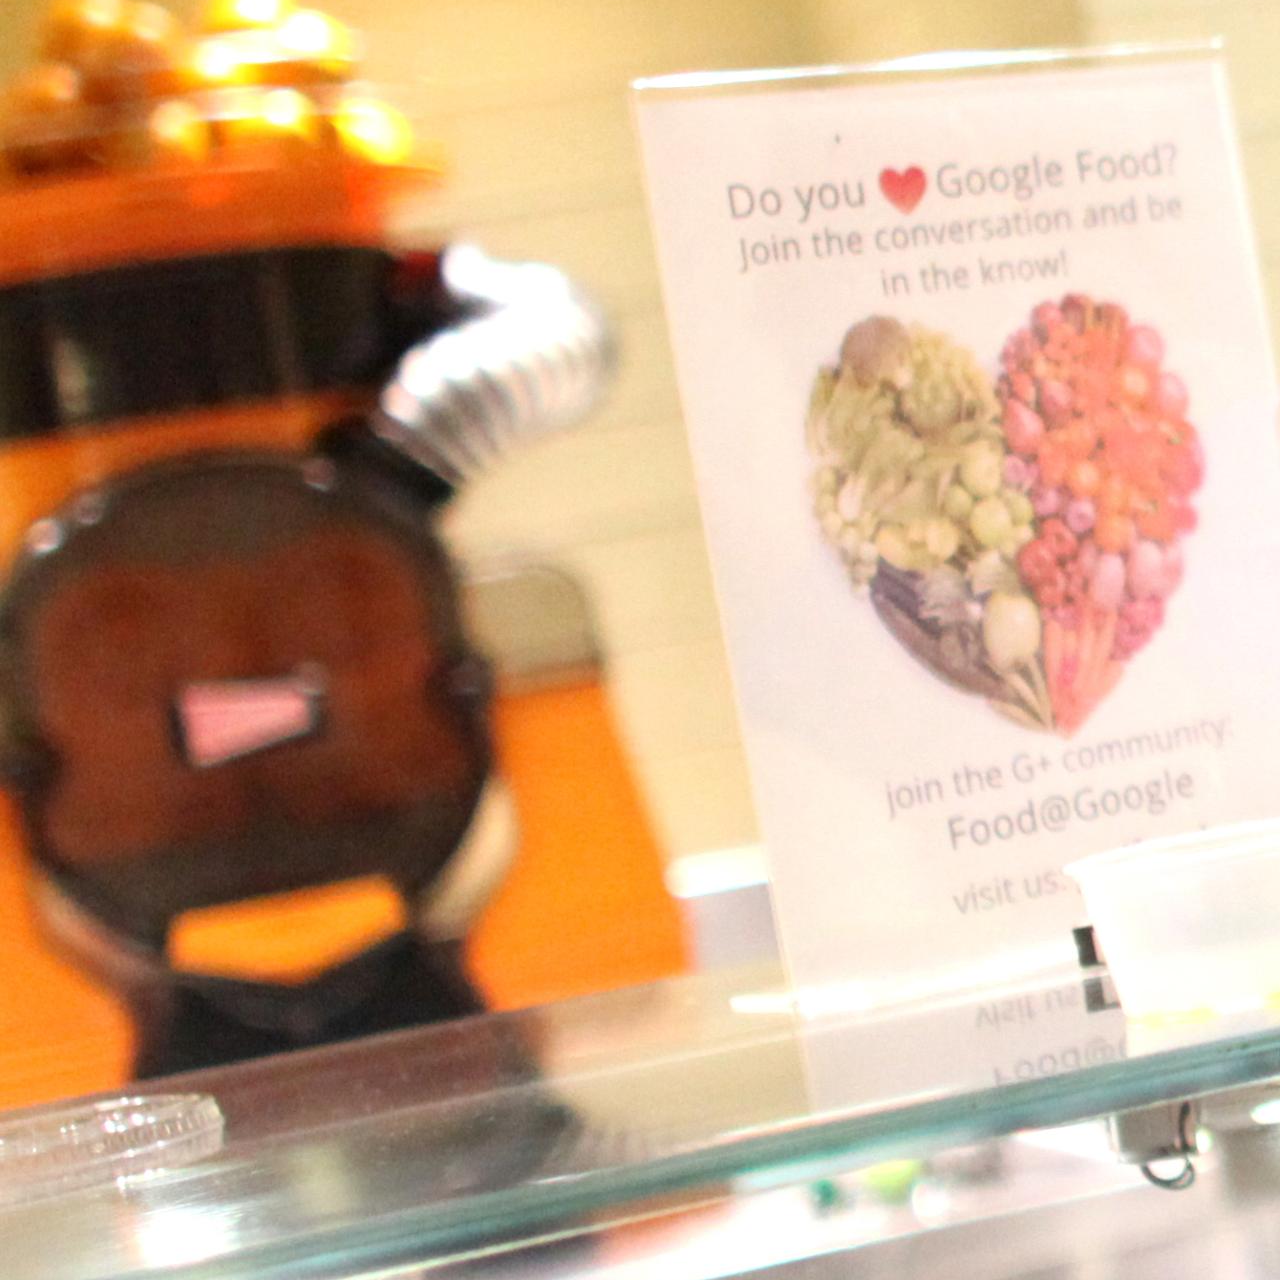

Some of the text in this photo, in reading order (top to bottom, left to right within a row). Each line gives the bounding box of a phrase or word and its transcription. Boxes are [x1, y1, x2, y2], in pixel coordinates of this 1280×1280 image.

[727, 143, 1178, 223] Do you Google Food?
[739, 192, 1183, 274] Join the conversation and be
[881, 249, 1069, 297] in the know!
[886, 778, 944, 819] join
[953, 764, 1003, 797] the
[1012, 752, 1052, 783] G+
[947, 769, 1196, 850] Food@Google
[953, 875, 1016, 915] visit
